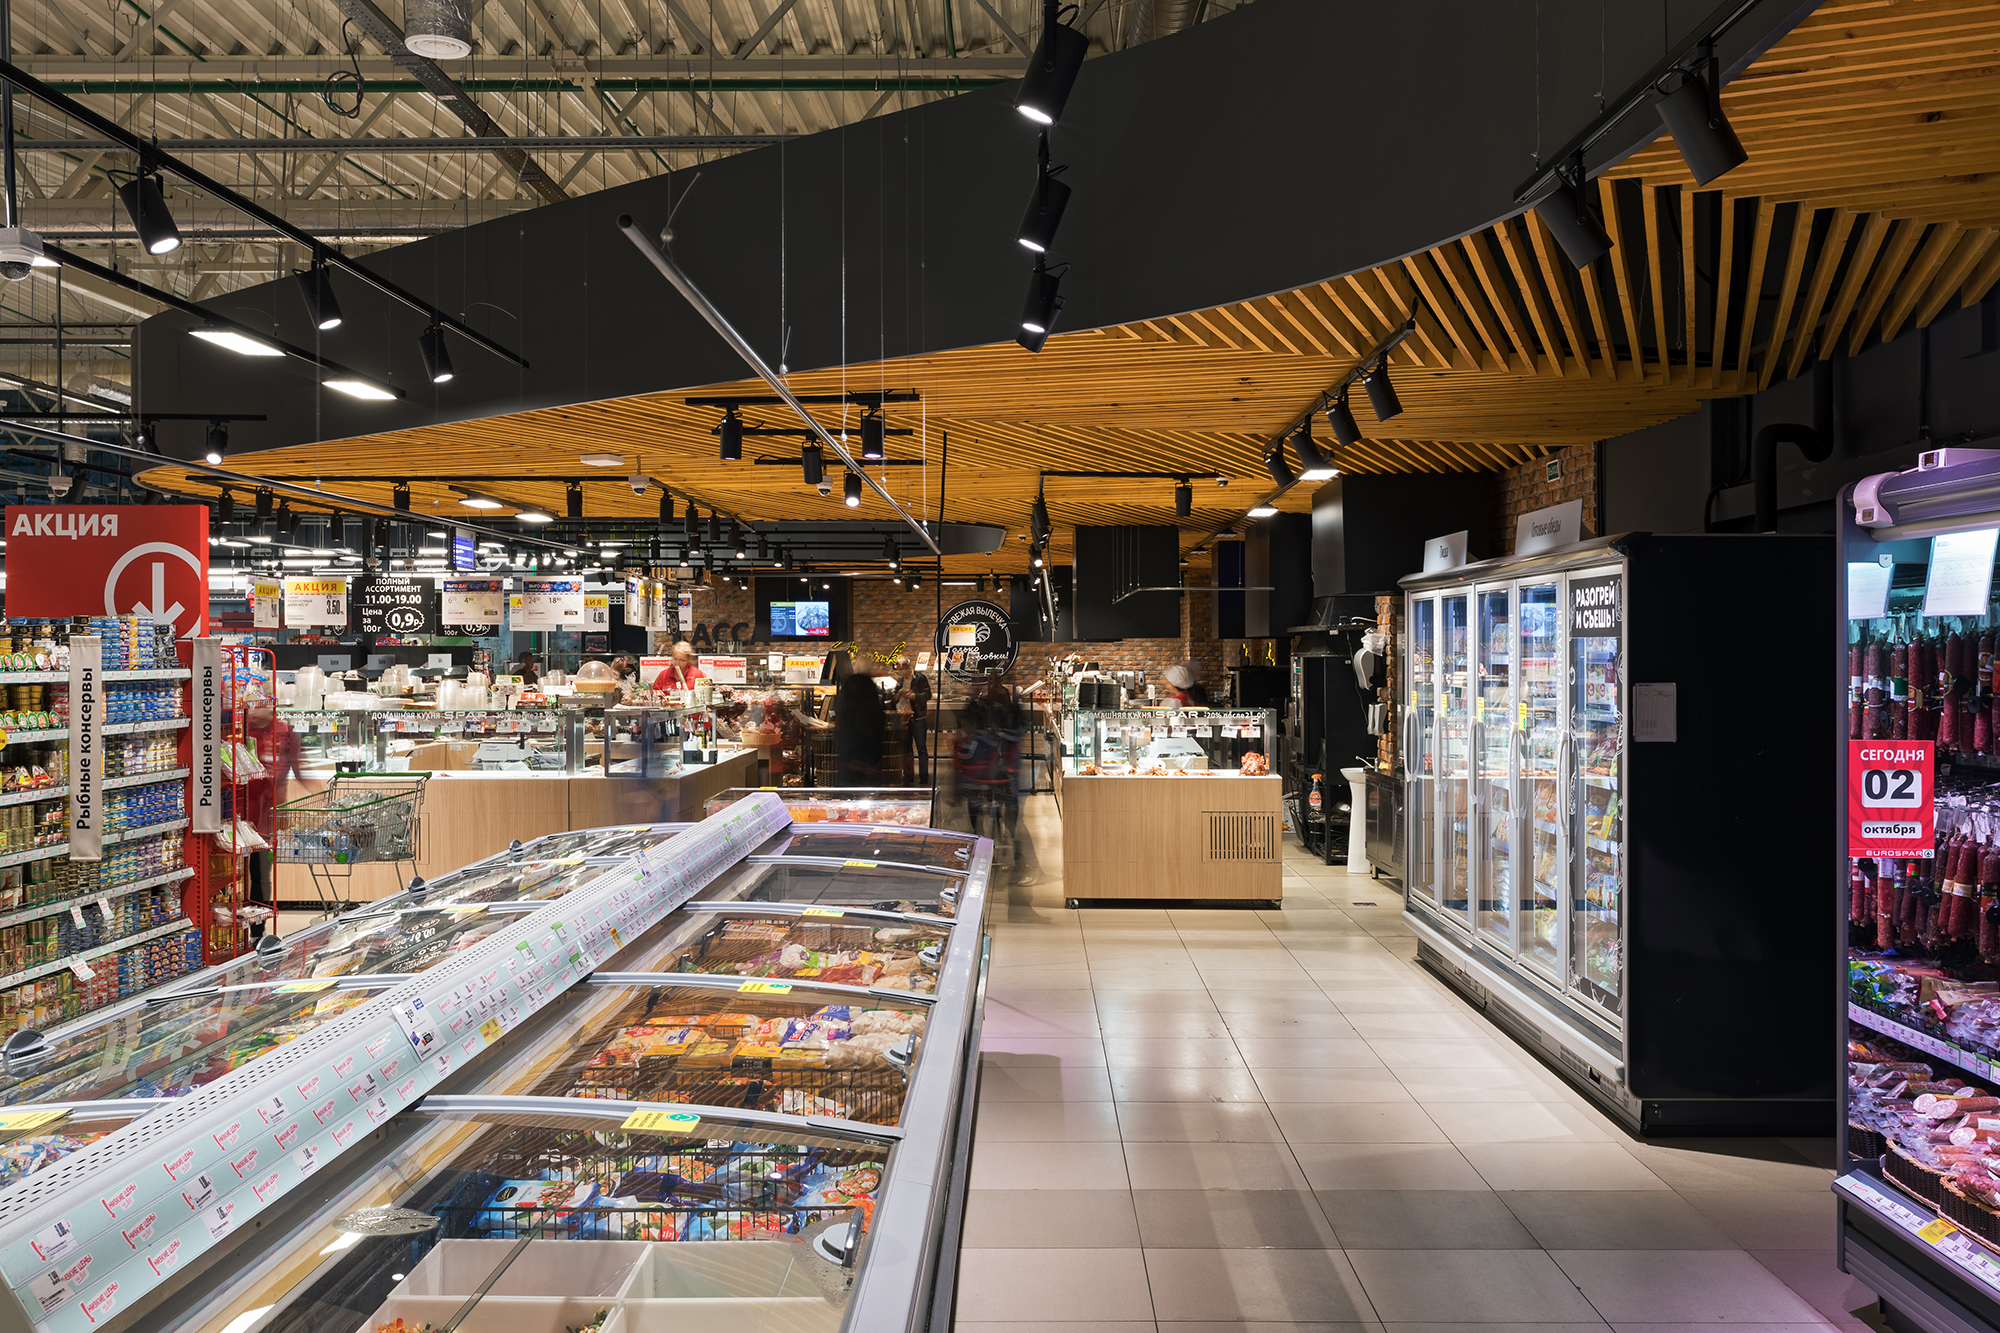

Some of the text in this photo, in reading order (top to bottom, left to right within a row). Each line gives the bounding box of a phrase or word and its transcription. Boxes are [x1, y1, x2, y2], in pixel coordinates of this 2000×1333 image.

[12, 514, 118, 540] АКЦИЯ
[294, 583, 337, 592] АКЦИЯ
[376, 576, 410, 585] ПОЛНЫЙ
[259, 586, 276, 596] АКЦИЯ
[1575, 580, 1615, 607] РАЗОГРЕЙ
[364, 594, 422, 604] 11.00-19.00
[326, 600, 340, 615] 3.50
[362, 608, 382, 616] Цена
[976, 606, 1008, 630] ВЫПЕЧКА
[1575, 608, 1615, 628] И СЪЕШЬ!
[372, 712, 415, 720] ДОМАШНЯЯ
[200, 666, 215, 806] Рыбные консервы
[76, 668, 96, 830] Рыбные консервы
[1860, 749, 1924, 764] СЕГОДНЯ
[1864, 769, 1915, 800] 02
[1864, 824, 1916, 836] октября
[123, 1182, 137, 1197] ЦЕНЫ
[143, 1213, 156, 1228] ЦЕНЫ
[168, 1239, 181, 1254] ЦЕНЫ
[104, 1281, 119, 1298] ЦЕНЫ
